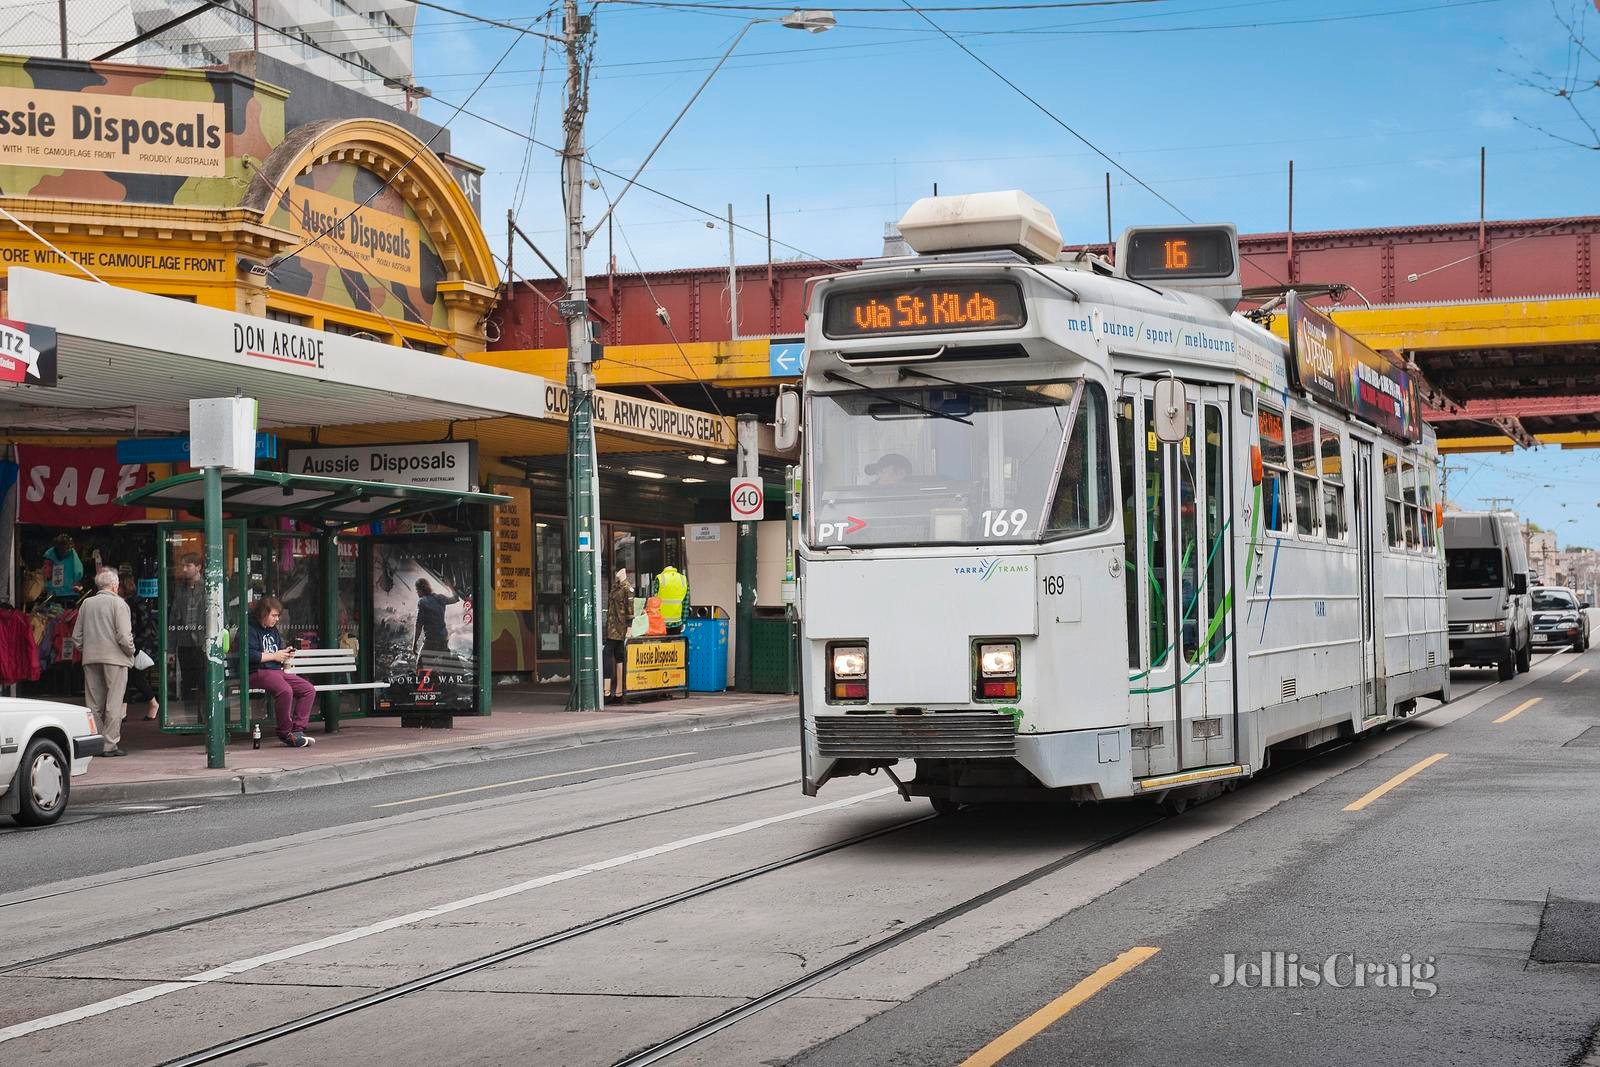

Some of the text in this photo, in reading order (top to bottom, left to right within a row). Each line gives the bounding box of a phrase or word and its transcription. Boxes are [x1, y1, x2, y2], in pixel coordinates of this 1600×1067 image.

[72, 105, 221, 155] Disposals
[3, 145, 219, 166] WITH THE CAMOUFLAGE FRONT PROUDLY AUSTRALIAN
[302, 199, 346, 241] Aussie
[350, 208, 411, 260] Disposals
[34, 249, 66, 263] WITH
[70, 251, 95, 265] THE
[98, 253, 180, 271] CAMOUFLAGE
[184, 258, 226, 273] FRONT.
[1163, 240, 1189, 269] 16
[855, 292, 995, 328] via St Kilda
[234, 322, 325, 368] DON ARCADE
[1067, 316, 1235, 353] melourne sport melbourne
[614, 399, 647, 429] ARMY
[649, 405, 694, 440] SURPLUS
[302, 451, 456, 474] Aussie Disposals
[25, 464, 142, 507] SALE
[736, 491, 758, 506] 40
[818, 522, 849, 542] PT
[982, 508, 1028, 538] 169
[954, 564, 1029, 574] YARRA TRAMS
[1042, 575, 1065, 595] 169
[635, 644, 678, 667] Aussie Disposals
[388, 675, 464, 685] WORLD WAR
[416, 668, 434, 691] Z
